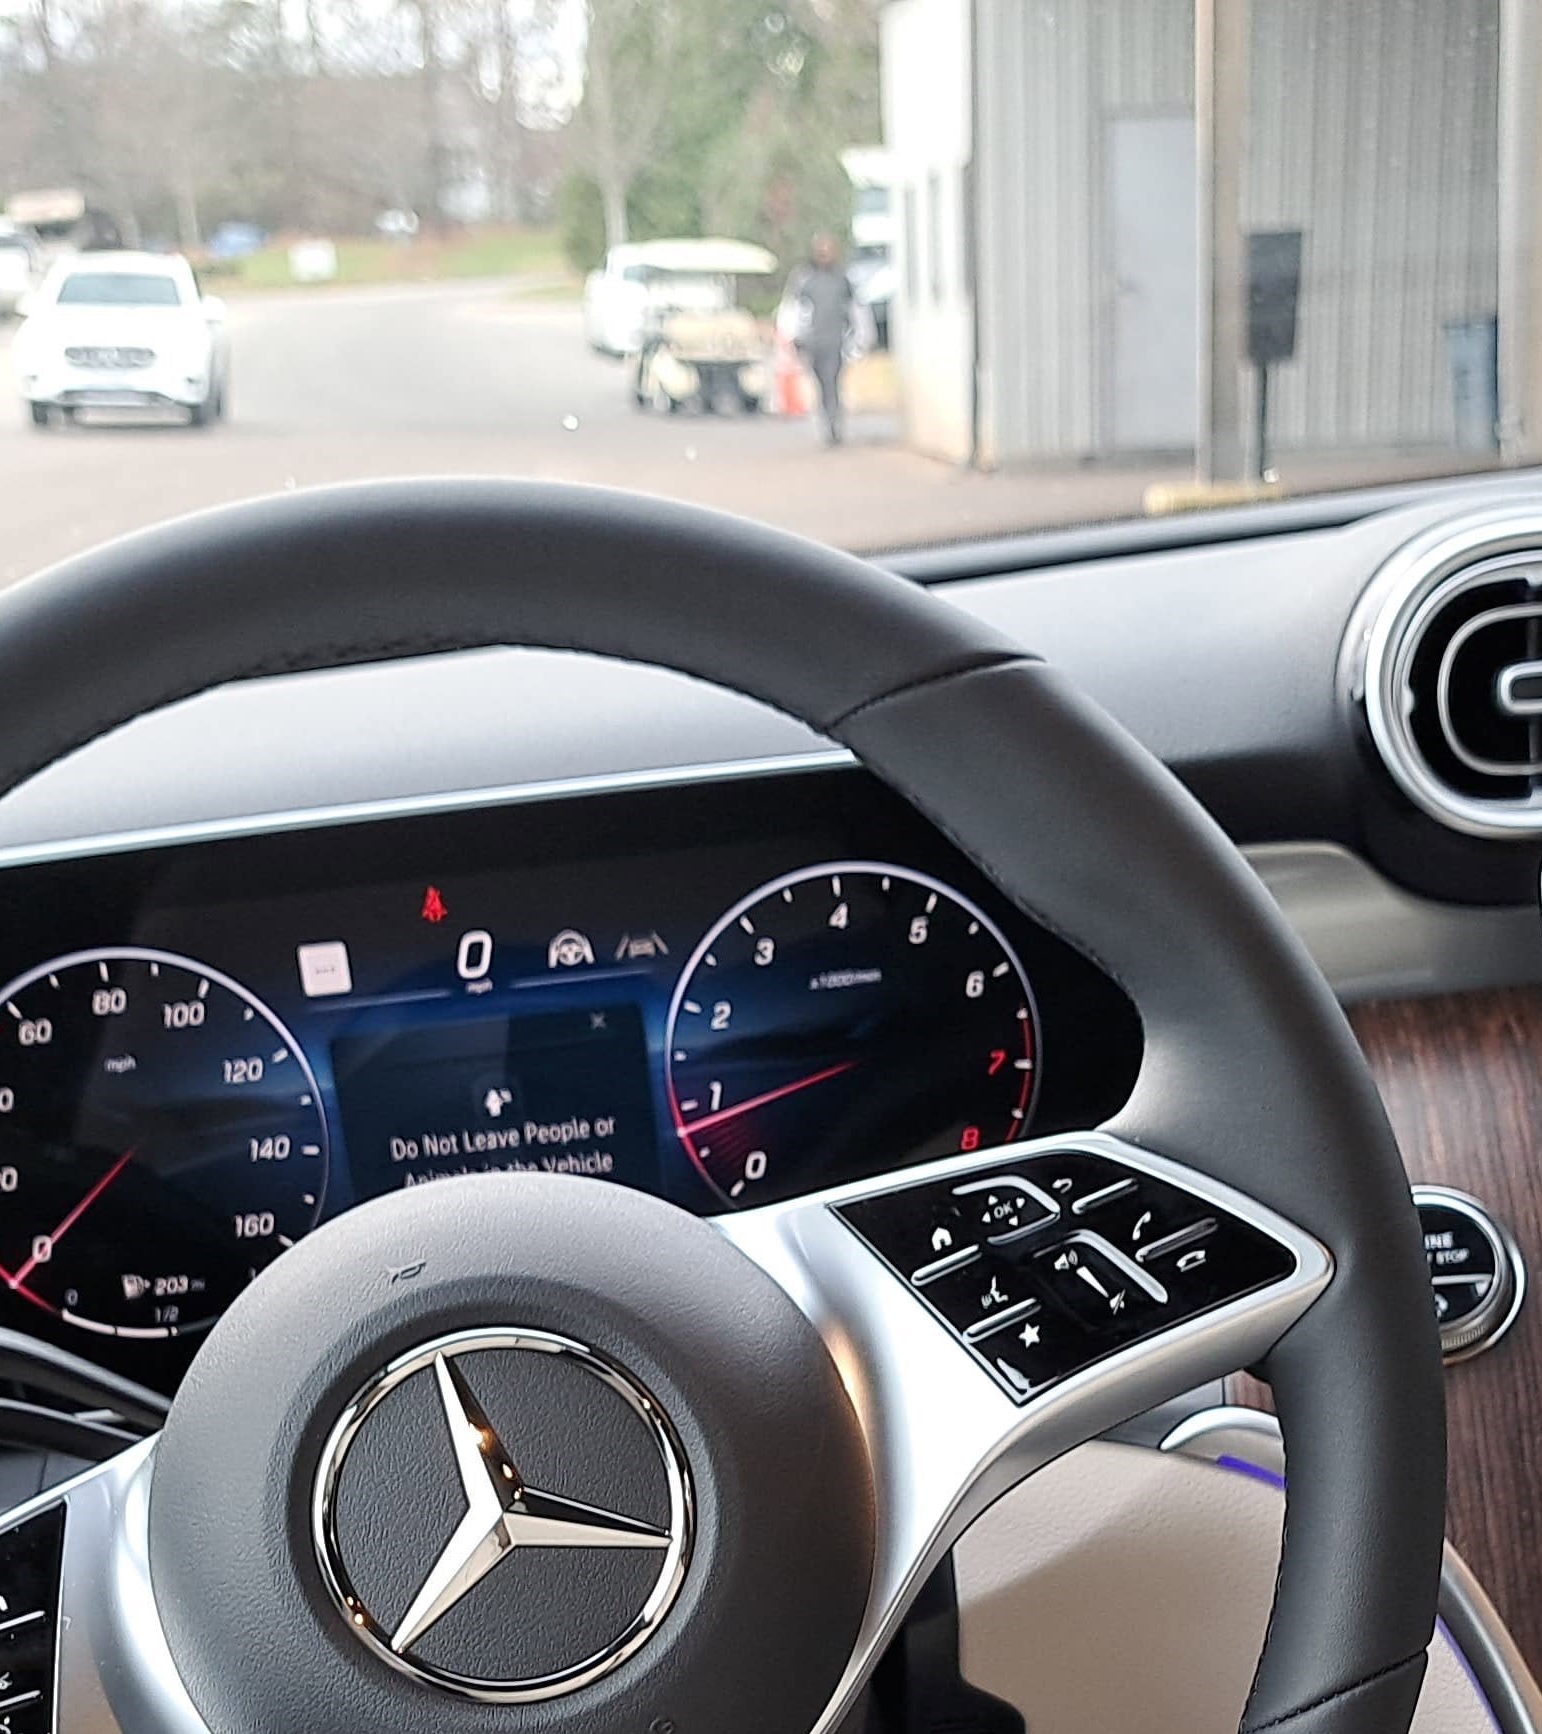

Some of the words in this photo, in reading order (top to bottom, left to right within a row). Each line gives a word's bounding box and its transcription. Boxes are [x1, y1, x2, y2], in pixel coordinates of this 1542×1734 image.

[828, 902, 849, 929] 4
[909, 916, 929, 944] 5
[457, 929, 492, 980] 0
[754, 937, 775, 965] 3
[965, 969, 985, 998] 6
[92, 987, 128, 1016] 80
[163, 1000, 206, 1028] 100
[710, 1001, 732, 1031] 2
[18, 1018, 53, 1046] 60
[105, 1055, 137, 1074] mph
[222, 1057, 264, 1084] 120
[988, 1049, 1006, 1076] 7
[709, 1080, 723, 1112] 1
[249, 1134, 291, 1162] 140
[390, 1136, 419, 1162] Do
[422, 1132, 459, 1157] Not
[462, 1127, 520, 1154] Leave
[523, 1115, 591, 1145] People
[594, 1116, 617, 1136] or
[960, 1125, 980, 1149] 8
[542, 1149, 614, 1175] Vehicle
[745, 1150, 767, 1180] 0
[233, 1211, 275, 1239] 160
[993, 1201, 1013, 1221] OK
[32, 1235, 53, 1263] 0
[64, 1288, 79, 1306] 0
[153, 1275, 189, 1296] 203
